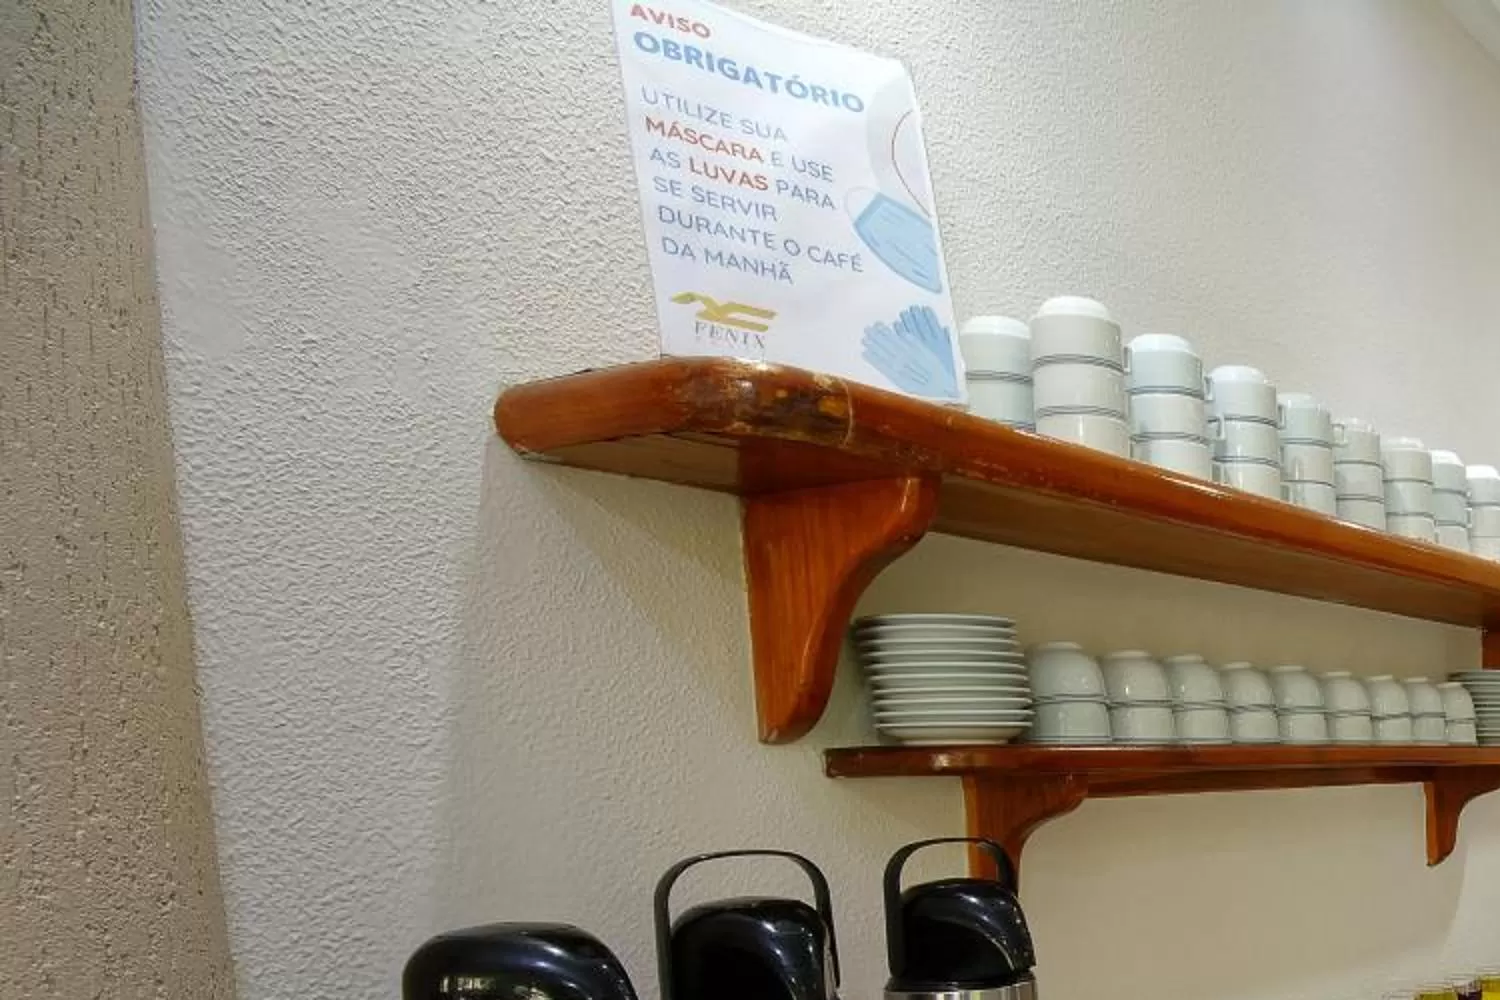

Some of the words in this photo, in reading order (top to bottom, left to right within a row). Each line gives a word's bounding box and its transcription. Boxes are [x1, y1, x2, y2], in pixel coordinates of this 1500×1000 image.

[631, 4, 710, 39] AVISO
[634, 31, 865, 113] OBRIGATÓRIO
[641, 84, 734, 130] UTILIZE
[741, 119, 788, 142] SUA
[645, 115, 764, 164] MÁSCARA
[771, 151, 784, 167] E
[792, 154, 833, 183] USE
[650, 147, 681, 169] AS
[688, 156, 769, 191] LUVAS
[776, 179, 836, 210] PARA
[653, 175, 682, 198] SE
[691, 184, 777, 222] SERVIR
[658, 205, 776, 251] DURANTE
[783, 239, 800, 256] O
[807, 245, 864, 273] CAFÉ
[662, 236, 696, 261] DA
[704, 247, 794, 285] MANHÃ
